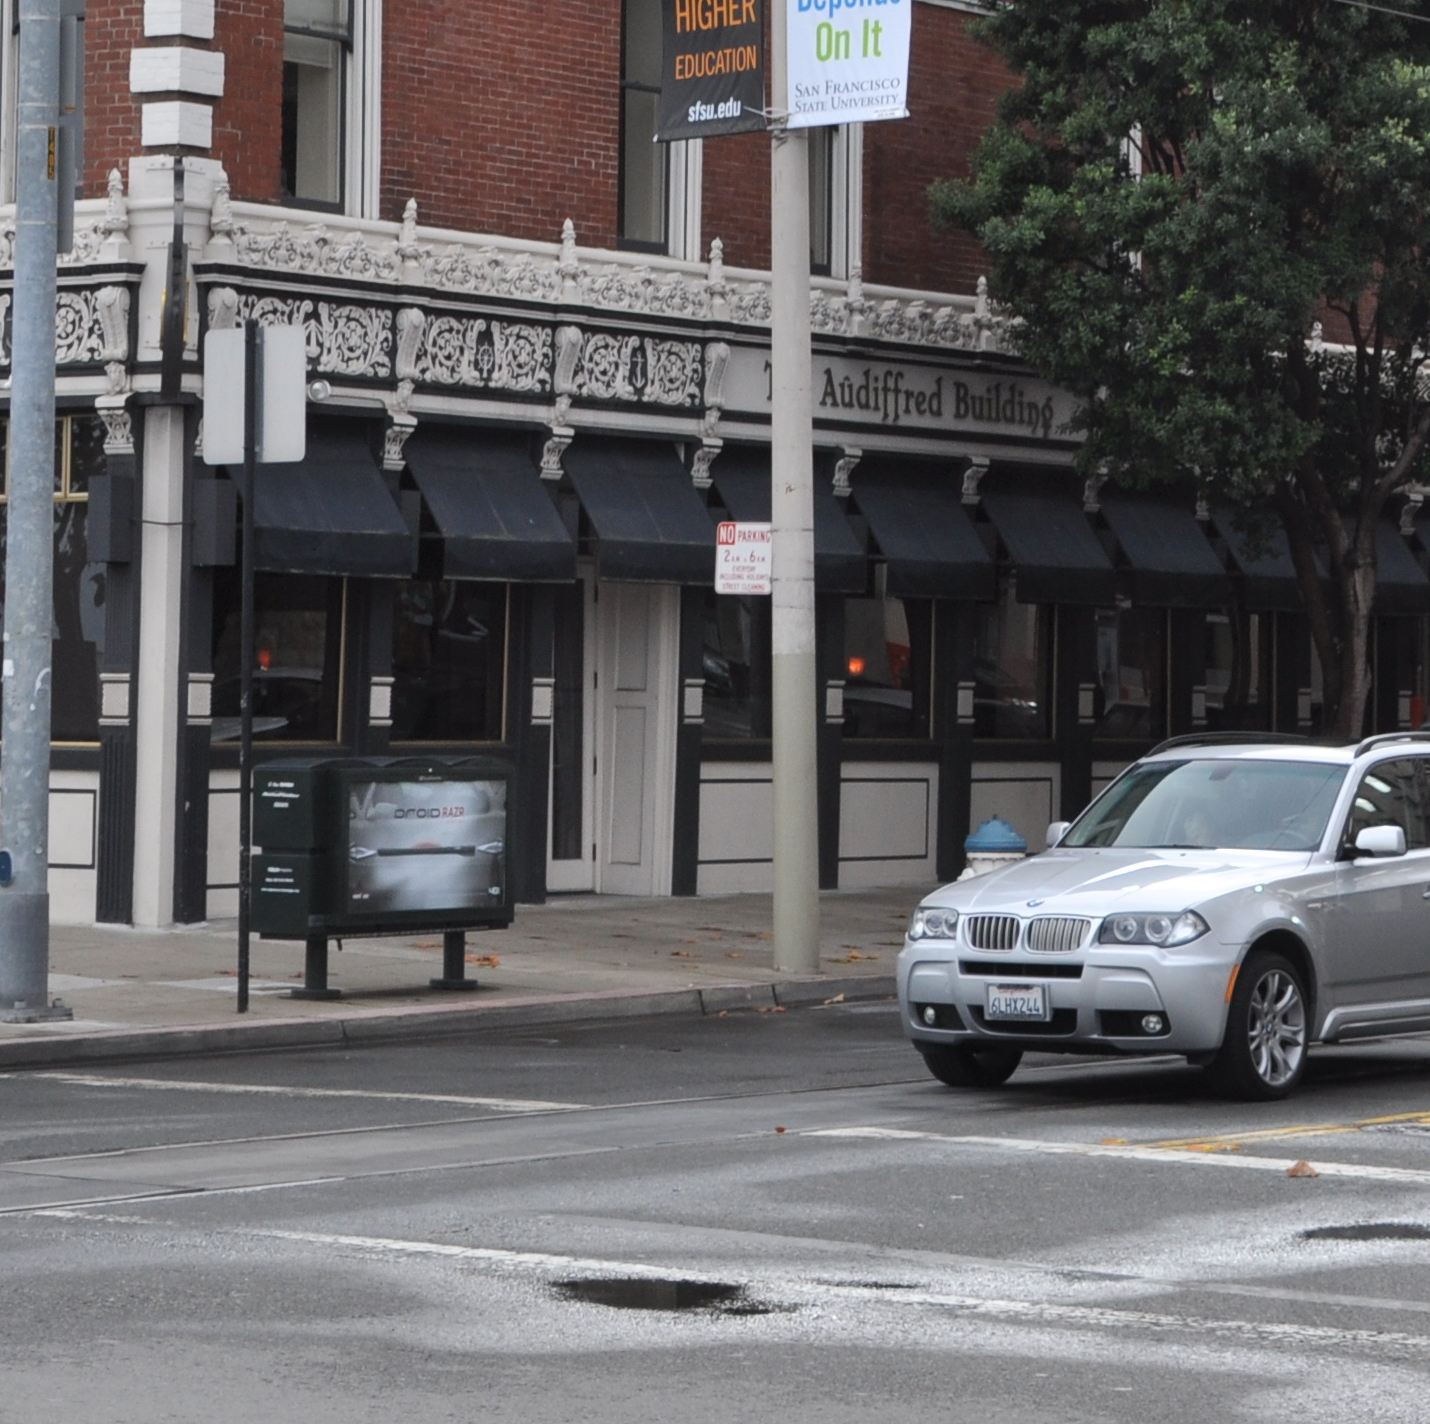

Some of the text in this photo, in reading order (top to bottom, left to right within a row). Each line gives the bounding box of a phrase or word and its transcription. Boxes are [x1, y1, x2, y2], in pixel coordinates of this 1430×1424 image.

[816, 19, 883, 62] On It
[675, 44, 757, 80] EDUCATION
[795, 77, 901, 98] SAN FRANCISCO
[688, 96, 741, 122] sfsu.edu
[794, 93, 899, 114] STATE UNIVERSITY
[953, 379, 1054, 439] Building
[720, 525, 771, 543] NO PARKING
[394, 806, 466, 819] DROID RAZR
[991, 997, 1040, 1014] 6LHX244
